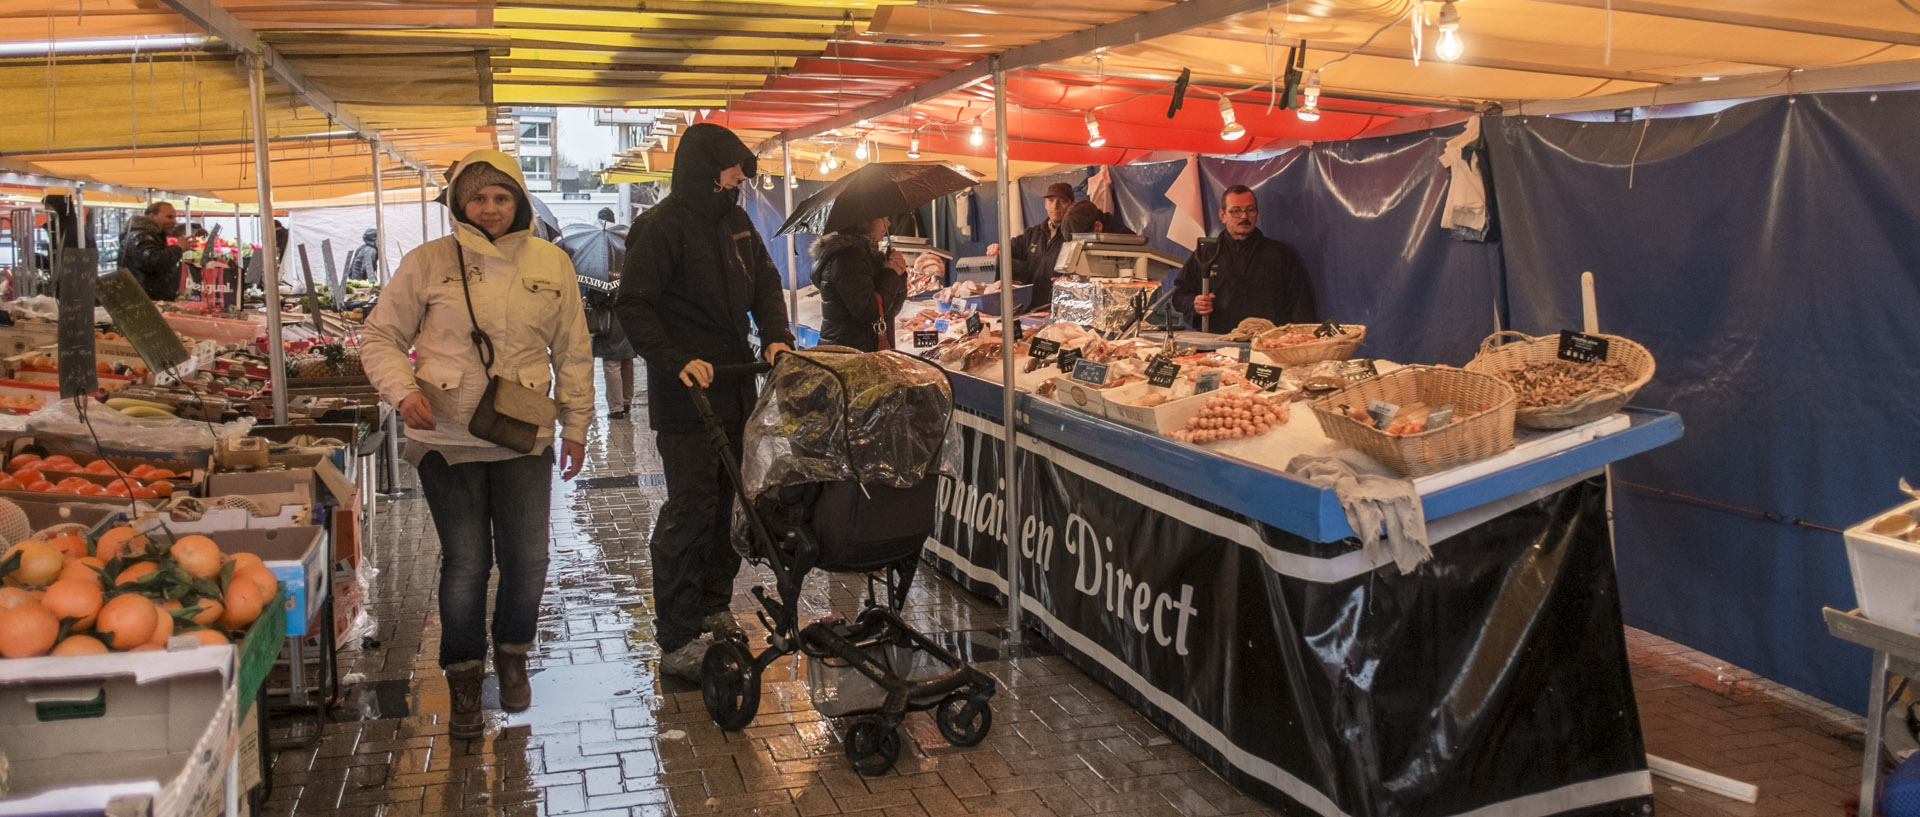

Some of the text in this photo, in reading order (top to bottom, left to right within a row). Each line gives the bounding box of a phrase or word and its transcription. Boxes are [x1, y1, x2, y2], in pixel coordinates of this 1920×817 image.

[937, 474, 1198, 656] onnai en Direct
